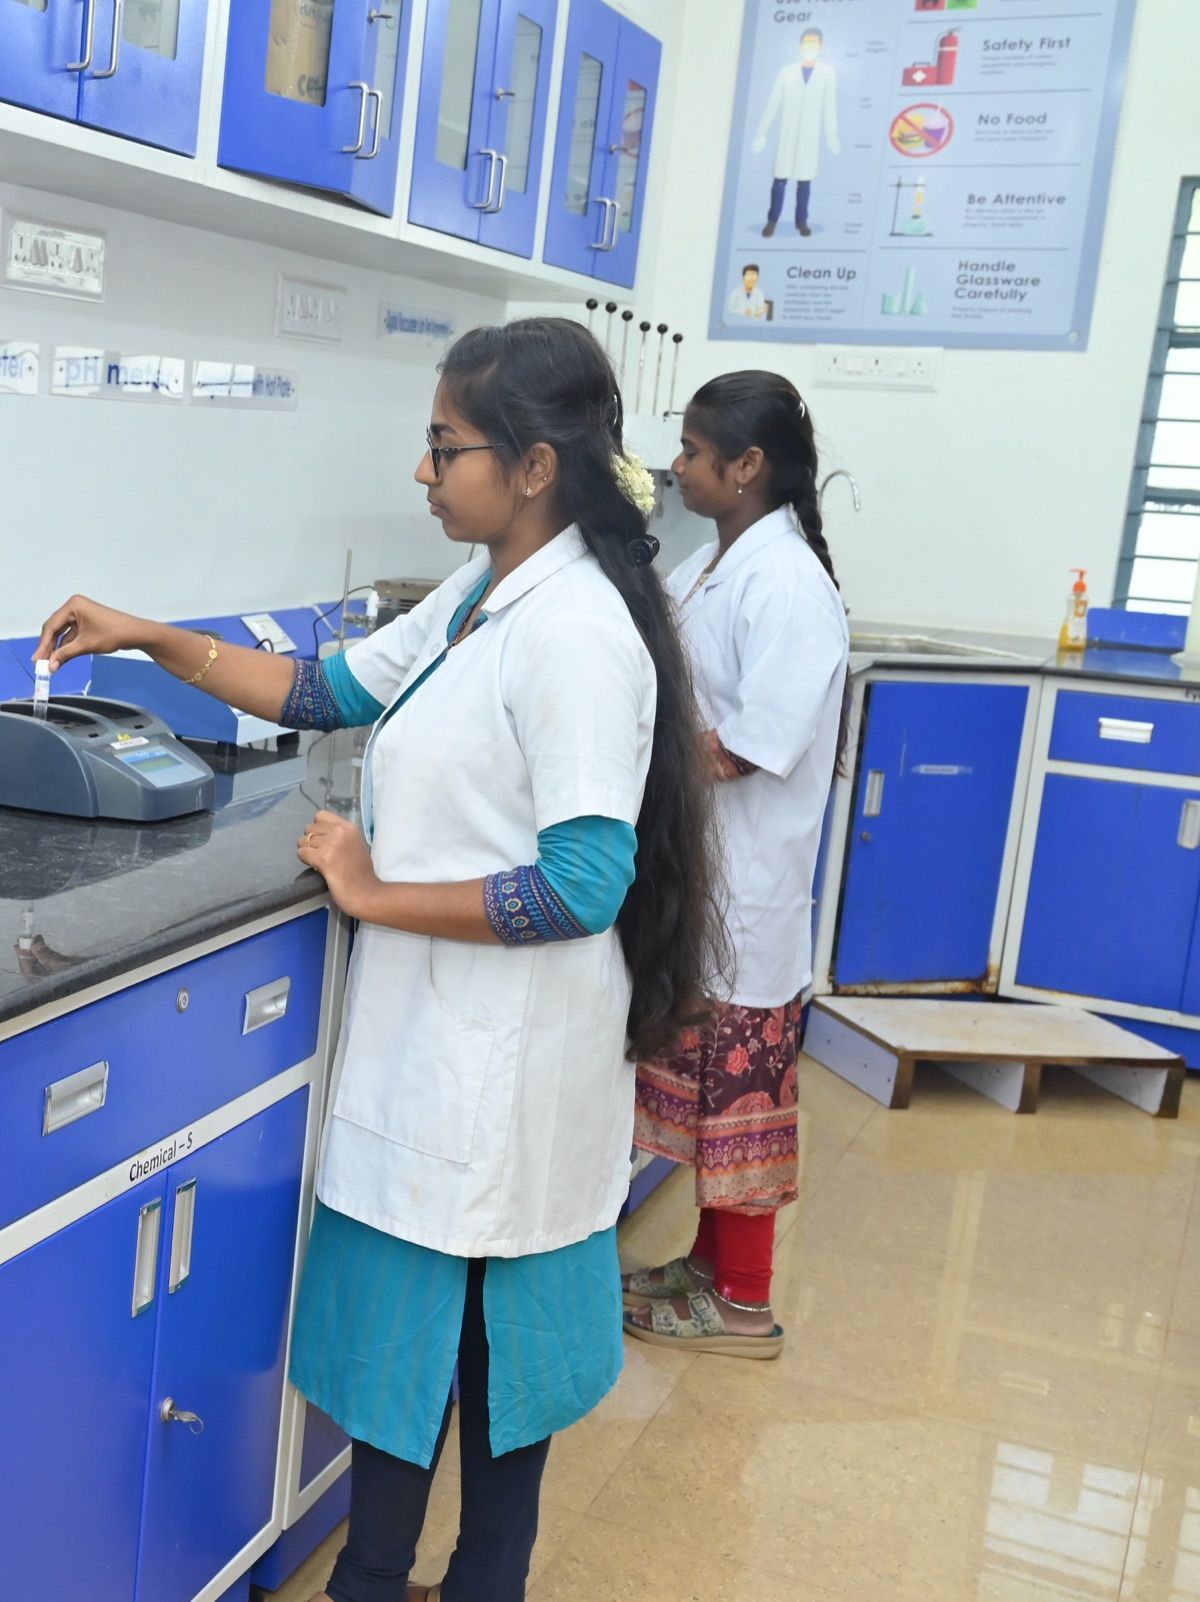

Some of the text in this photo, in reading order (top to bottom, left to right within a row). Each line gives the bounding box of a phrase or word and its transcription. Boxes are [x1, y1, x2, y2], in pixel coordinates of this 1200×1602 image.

[773, 10, 812, 23] Gear
[983, 36, 1071, 52] Safety First
[978, 112, 1047, 125] No Food
[967, 192, 1066, 205] Be Attentive
[958, 260, 1016, 272] Handle
[786, 266, 856, 282] Clean Up
[956, 274, 1041, 286] Glassware
[954, 287, 1028, 302] Carefully
[129, 1139, 177, 1182] Chemical
[187, 1131, 193, 1149] S
